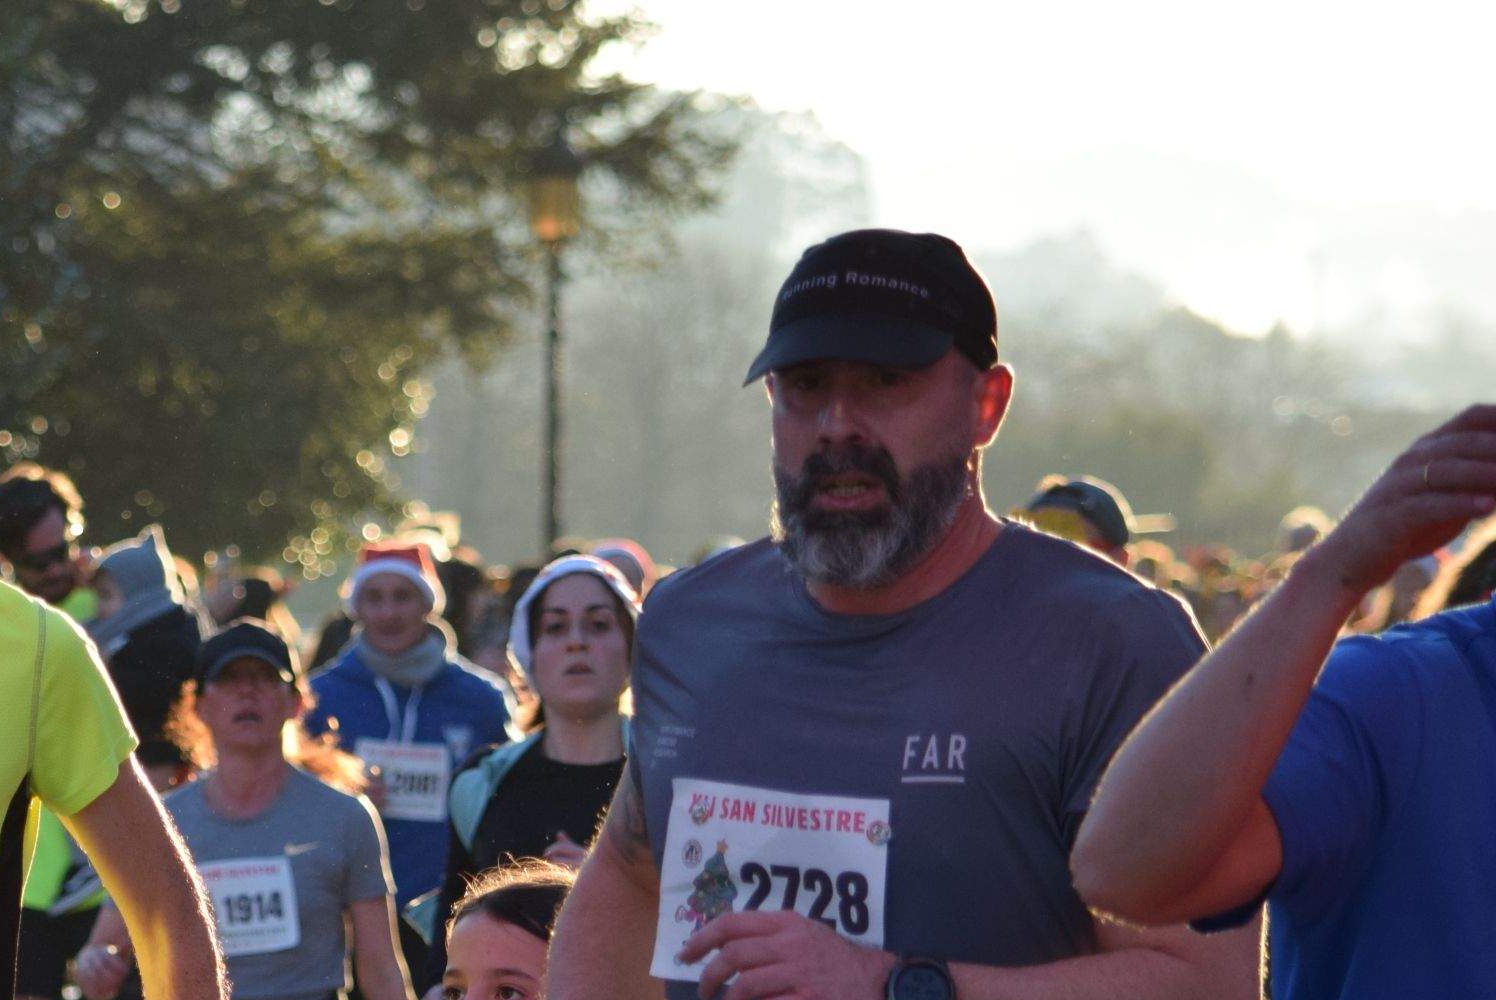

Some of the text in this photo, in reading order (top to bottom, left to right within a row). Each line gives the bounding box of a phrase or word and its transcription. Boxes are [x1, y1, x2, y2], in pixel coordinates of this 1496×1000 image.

[846, 271, 928, 298] Romance
[903, 734, 967, 771] FAR
[689, 793, 866, 833] XI SAN SILVESTRE
[223, 891, 284, 923] 1914
[740, 862, 869, 935] 2728
